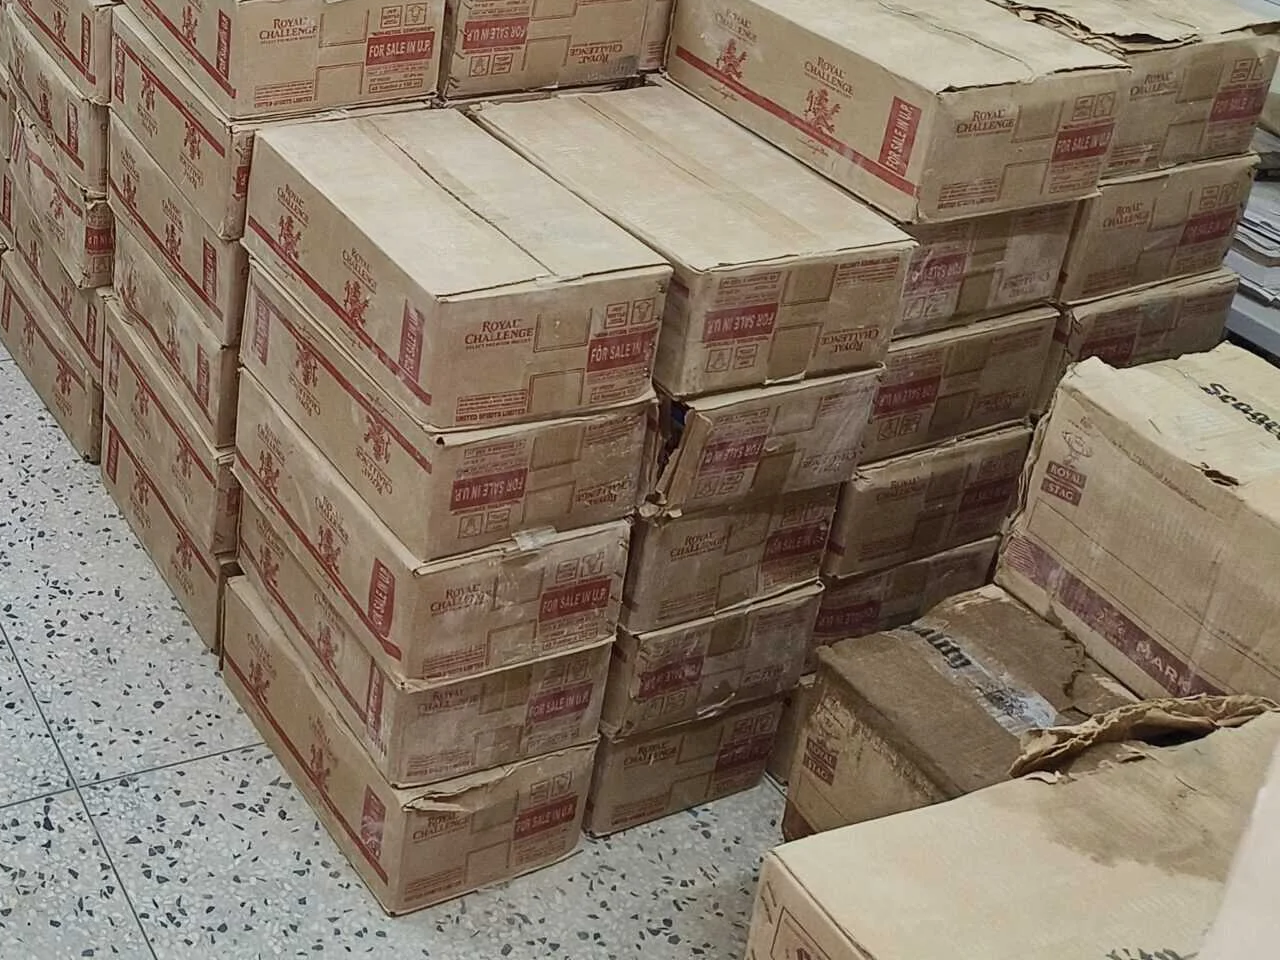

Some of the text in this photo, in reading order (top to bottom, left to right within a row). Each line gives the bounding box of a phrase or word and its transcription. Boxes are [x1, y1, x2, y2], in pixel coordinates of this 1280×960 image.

[273, 17, 307, 30] ROYAL
[259, 26, 318, 41] CHALLENGE
[369, 39, 432, 58] FOR SALE IN U.P.
[804, 60, 854, 96] CHALLENGE
[972, 110, 1005, 122] ROYAL
[956, 118, 1015, 134] CHALLENGE
[886, 104, 913, 171] FOR SALE IN U.P.
[482, 319, 520, 332] ROYAL
[464, 327, 535, 345] CHALLENGE
[591, 342, 642, 362] FOR SALE IN
[1051, 463, 1081, 484] ROYAL
[455, 477, 523, 501] FOR SALE IN U.P.
[1048, 483, 1074, 501] STAG
[542, 588, 608, 613] FOR SALE IN U.P.
